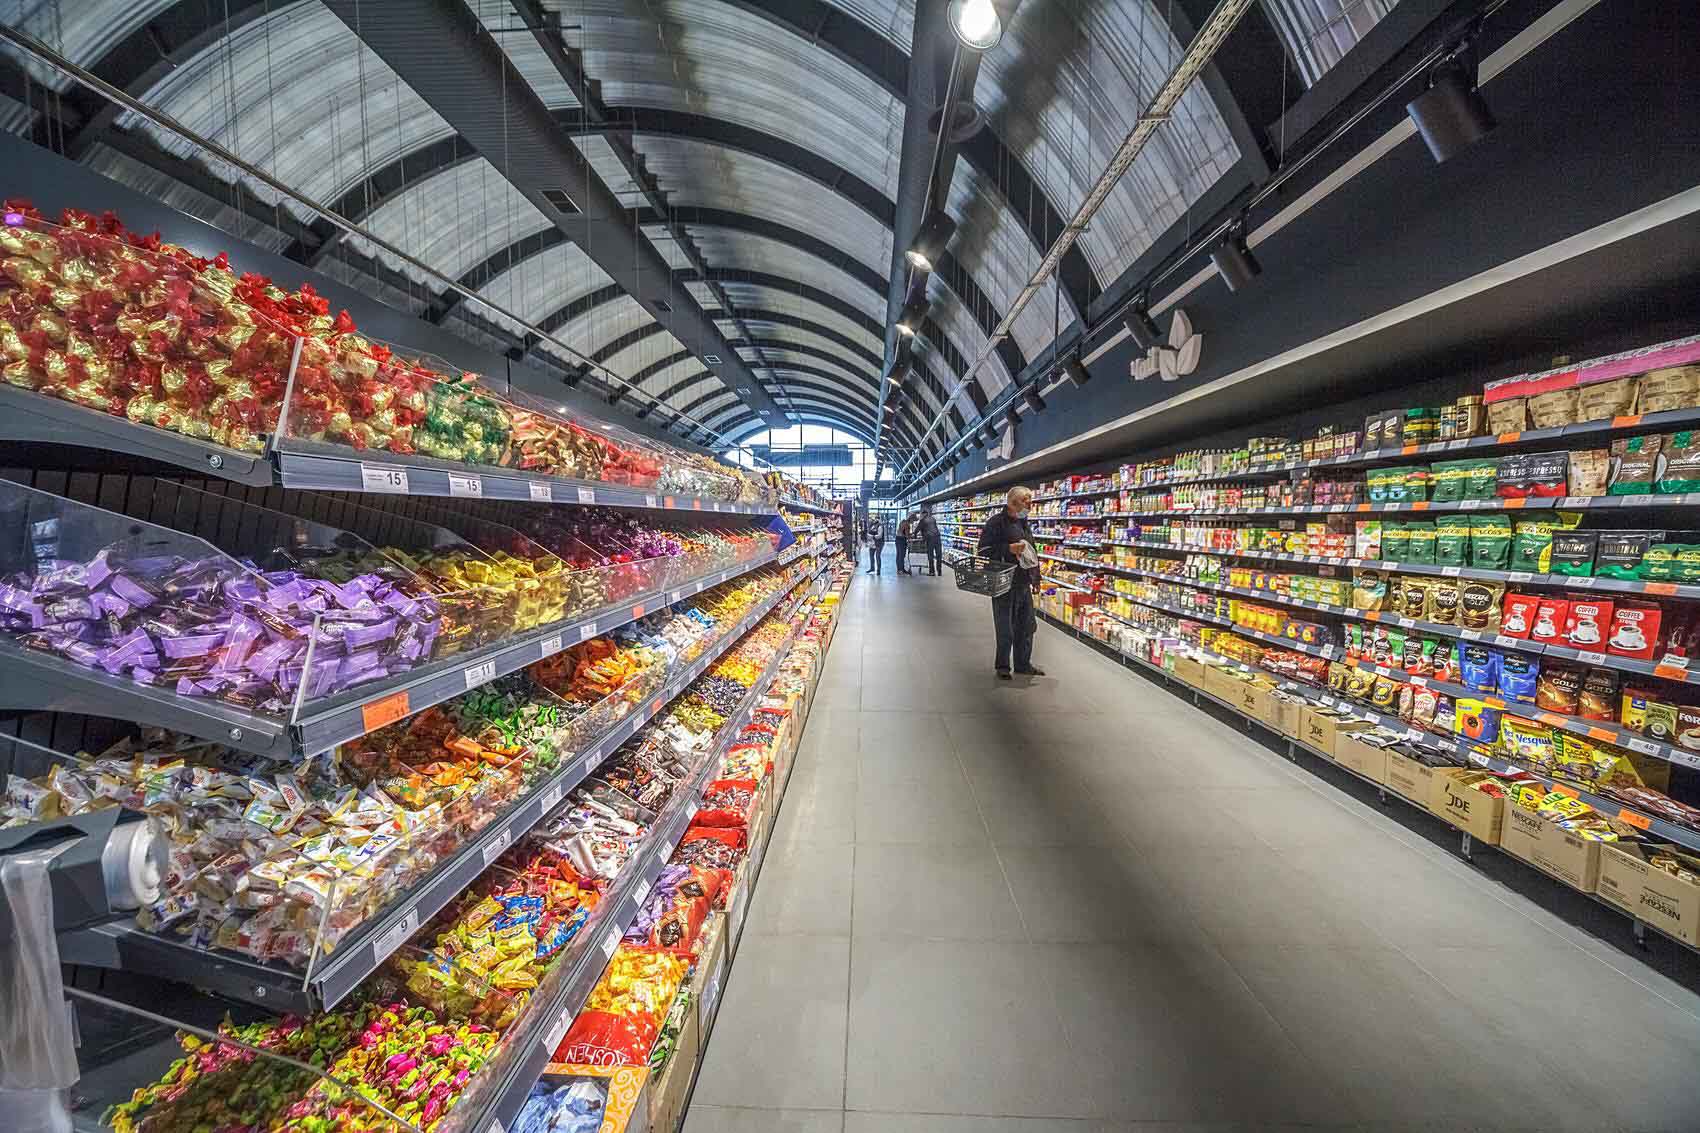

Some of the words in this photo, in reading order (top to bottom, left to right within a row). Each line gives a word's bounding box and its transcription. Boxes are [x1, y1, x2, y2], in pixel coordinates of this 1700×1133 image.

[387, 472, 401, 486] 15
[467, 480, 478, 492] 15
[1577, 605, 1597, 615] COFFEE
[1618, 610, 1640, 620] COFFEE
[1552, 677, 1578, 689] GOLD
[1584, 682, 1613, 694] GOLD
[1446, 793, 1470, 814] JDE
[400, 919, 408, 932] 9
